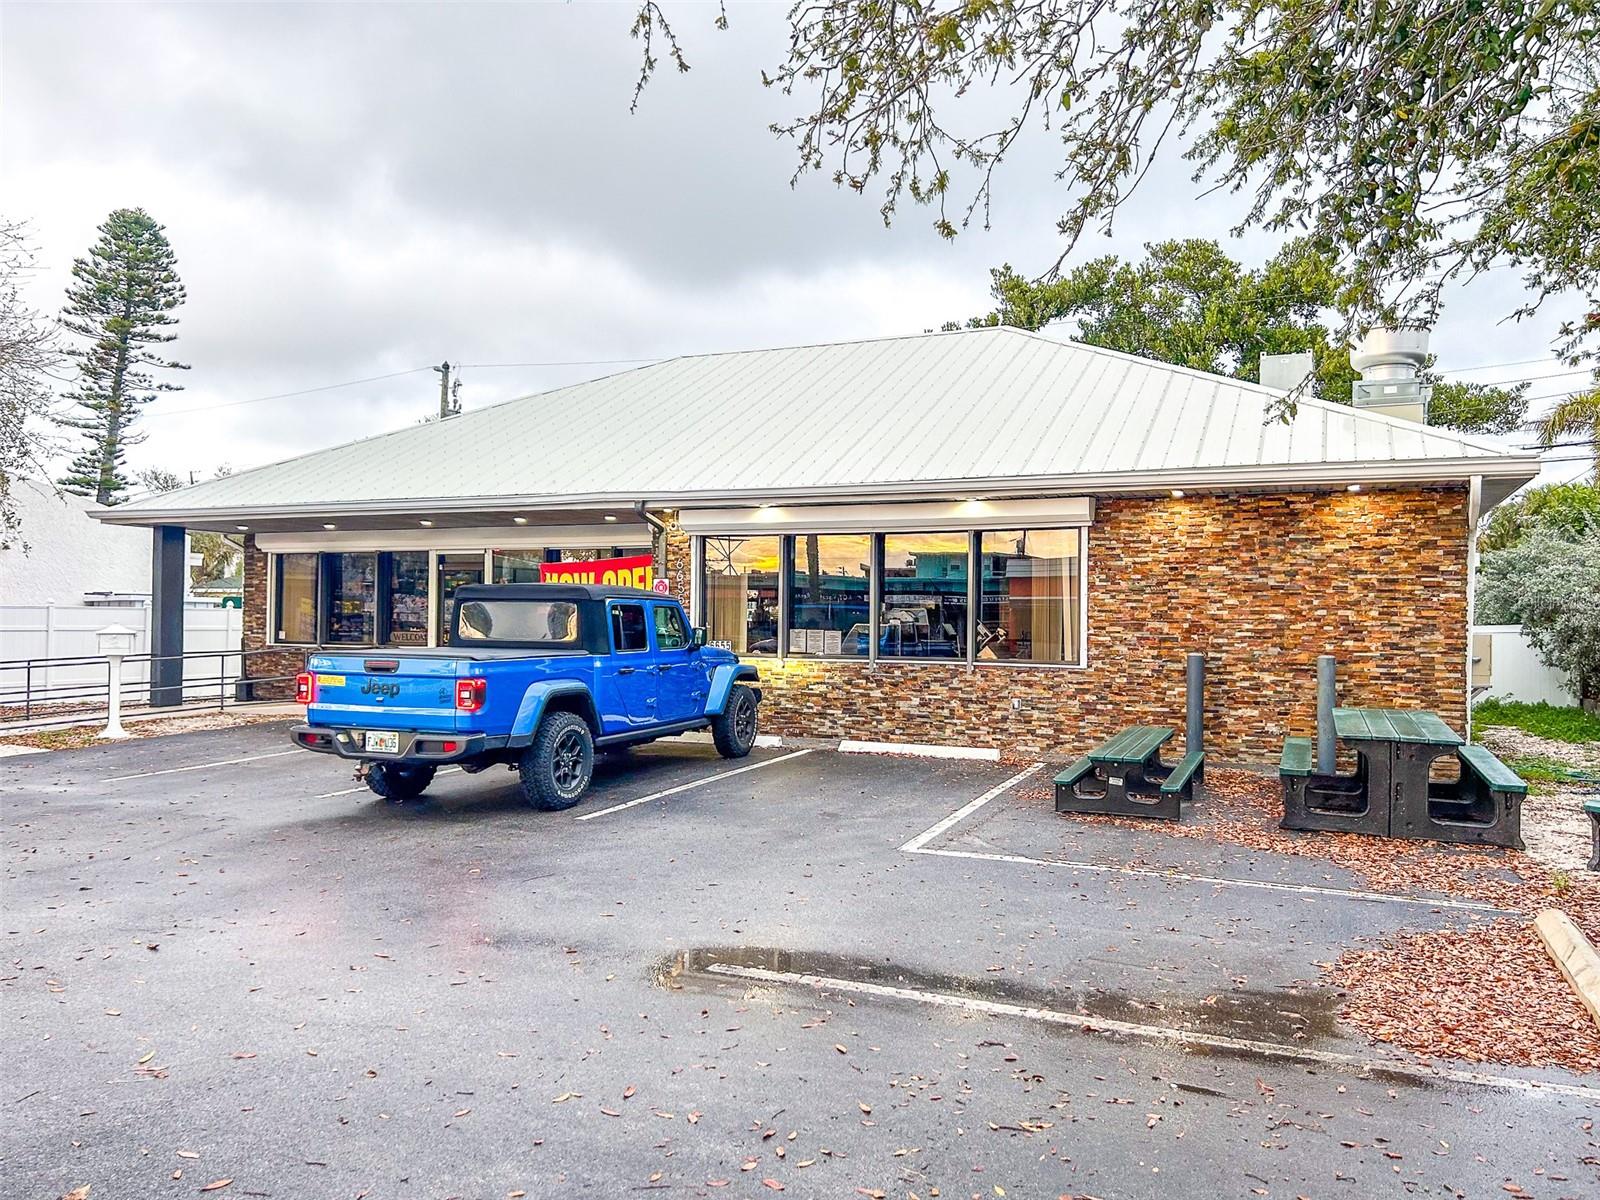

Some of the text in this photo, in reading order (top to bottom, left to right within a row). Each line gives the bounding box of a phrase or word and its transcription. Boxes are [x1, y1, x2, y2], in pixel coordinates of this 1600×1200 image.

[676, 558, 685, 604] 6655
[709, 641, 731, 650] 6655
[360, 678, 401, 698] Jeep
